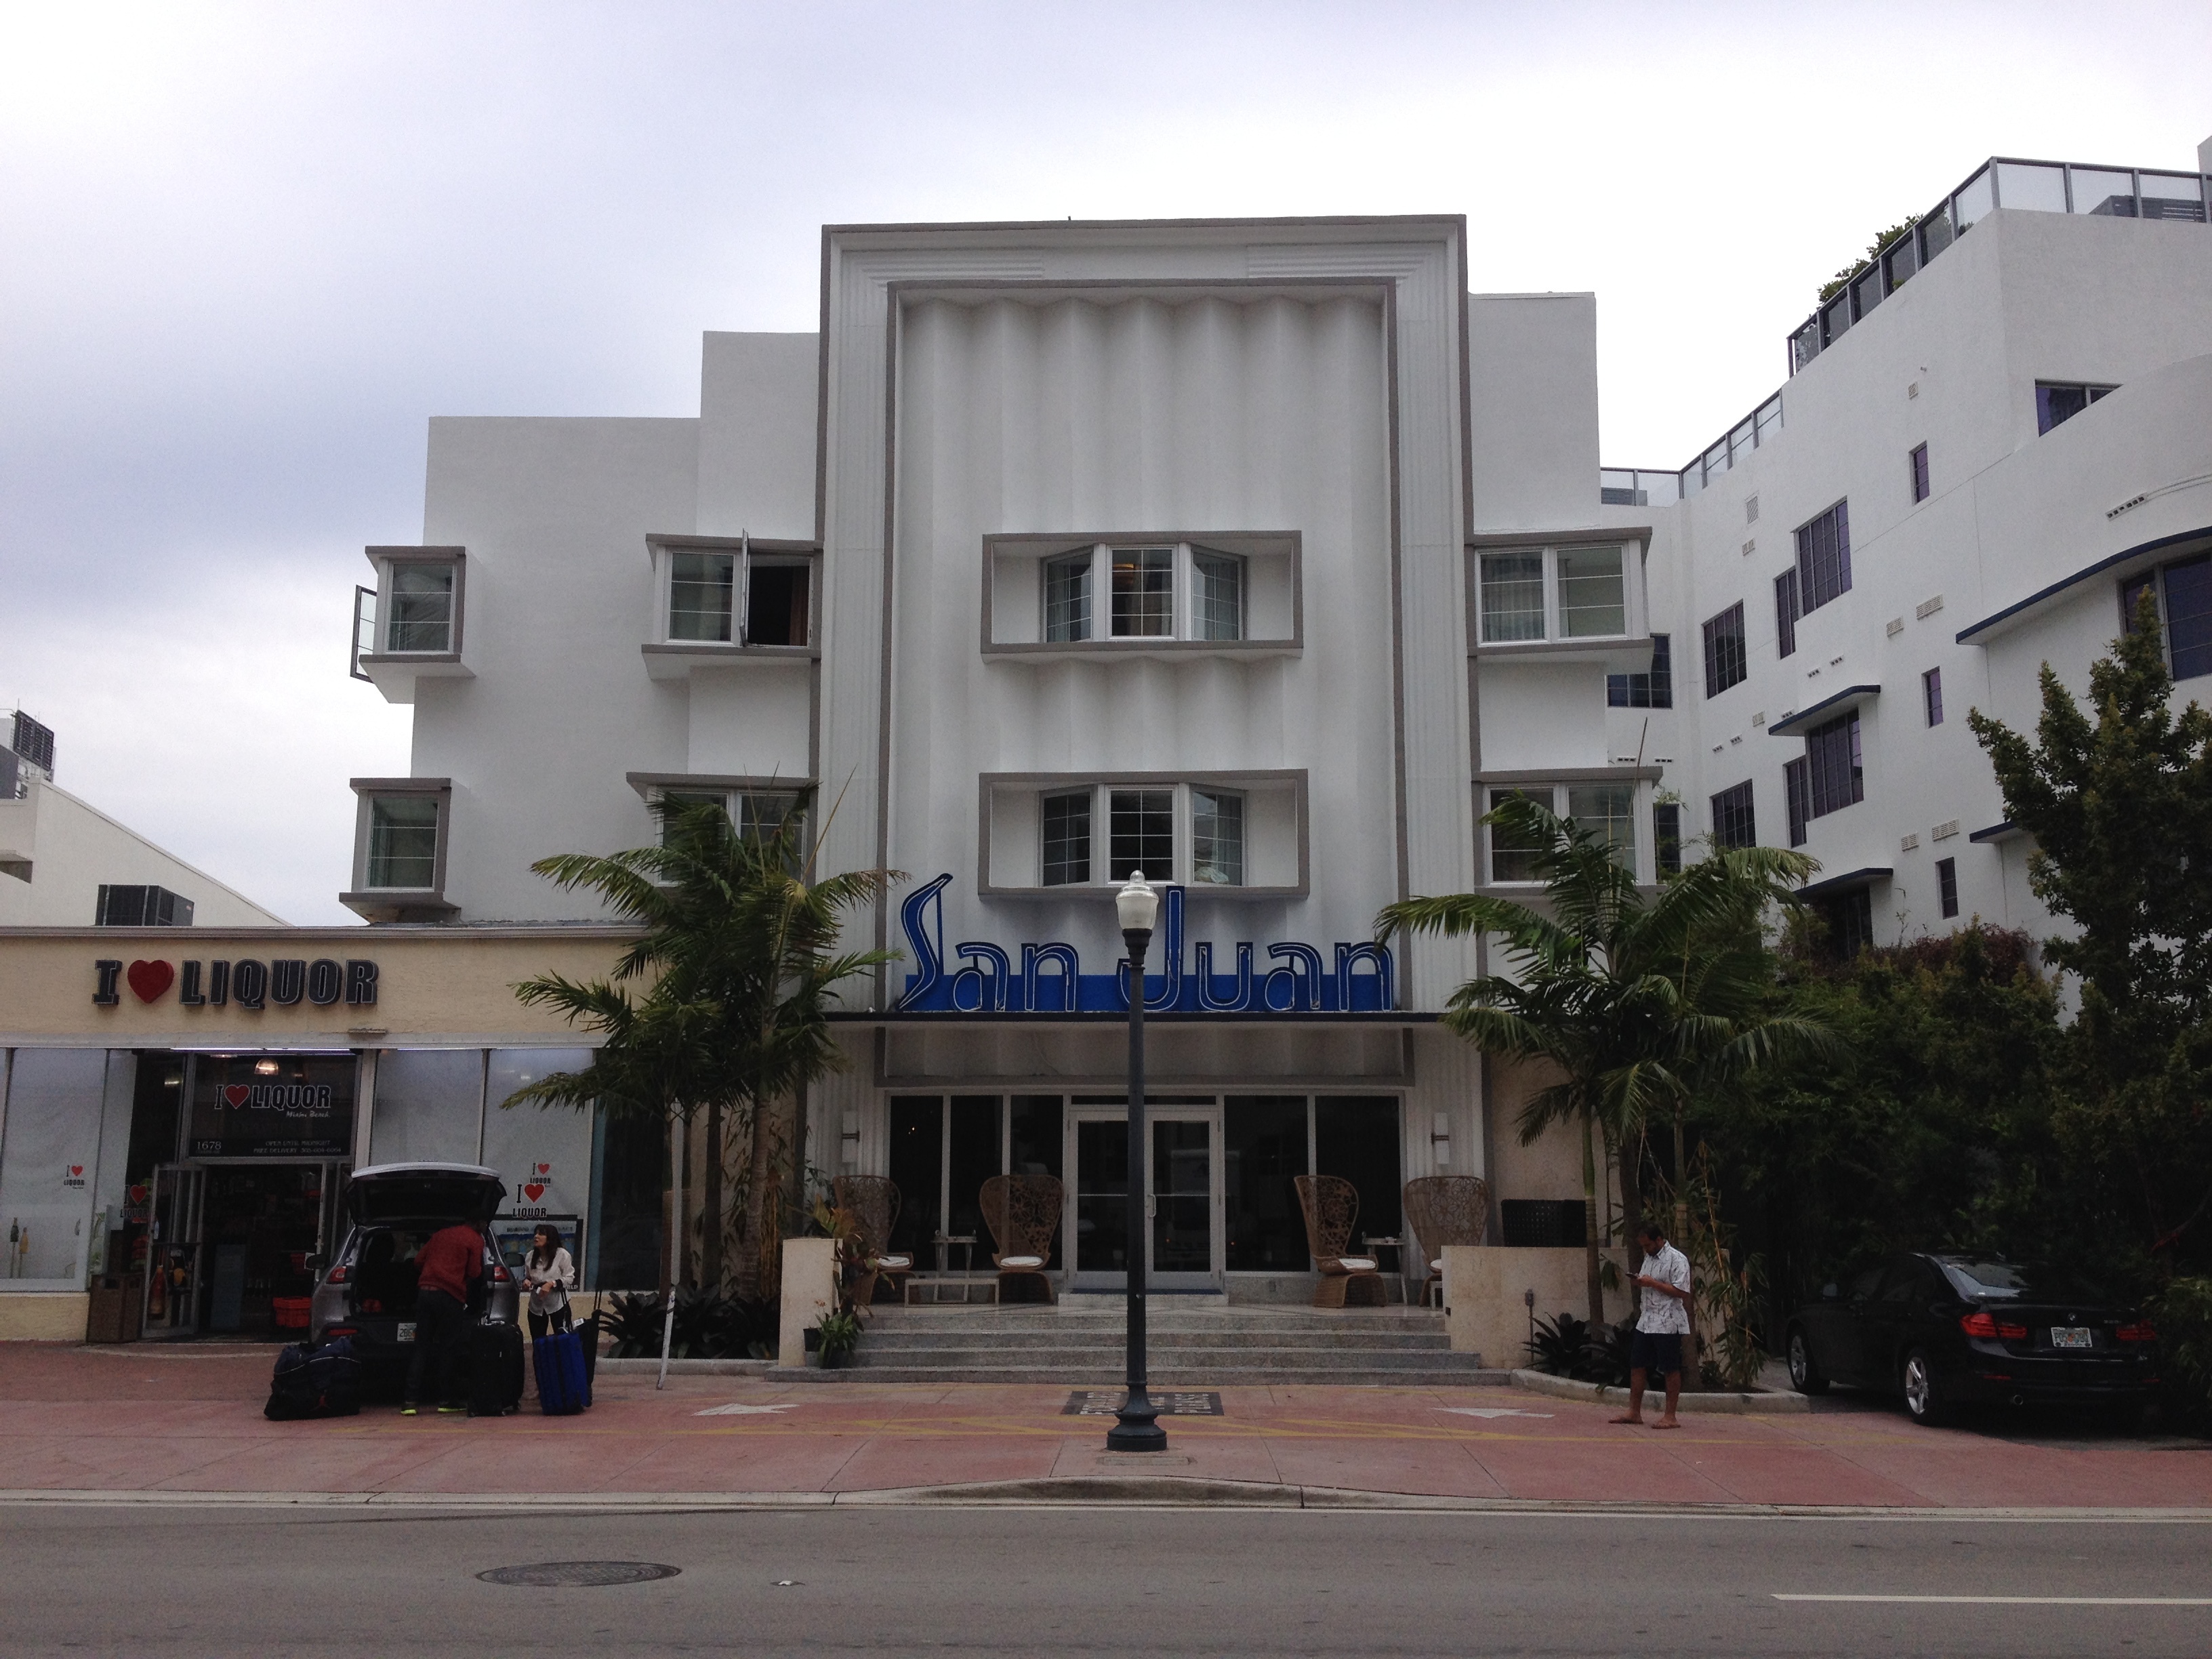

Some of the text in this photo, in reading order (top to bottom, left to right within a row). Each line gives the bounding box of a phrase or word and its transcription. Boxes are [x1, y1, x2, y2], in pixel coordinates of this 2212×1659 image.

[897, 872, 1395, 1012] San Juan
[91, 958, 380, 1009] I LIQUOR
[214, 1084, 331, 1111] I LIQUOR
[197, 1141, 222, 1150] 1678
[516, 1184, 523, 1204] I
[119, 1208, 148, 1218] LIQUOR
[512, 1207, 548, 1218] LIQUOR
